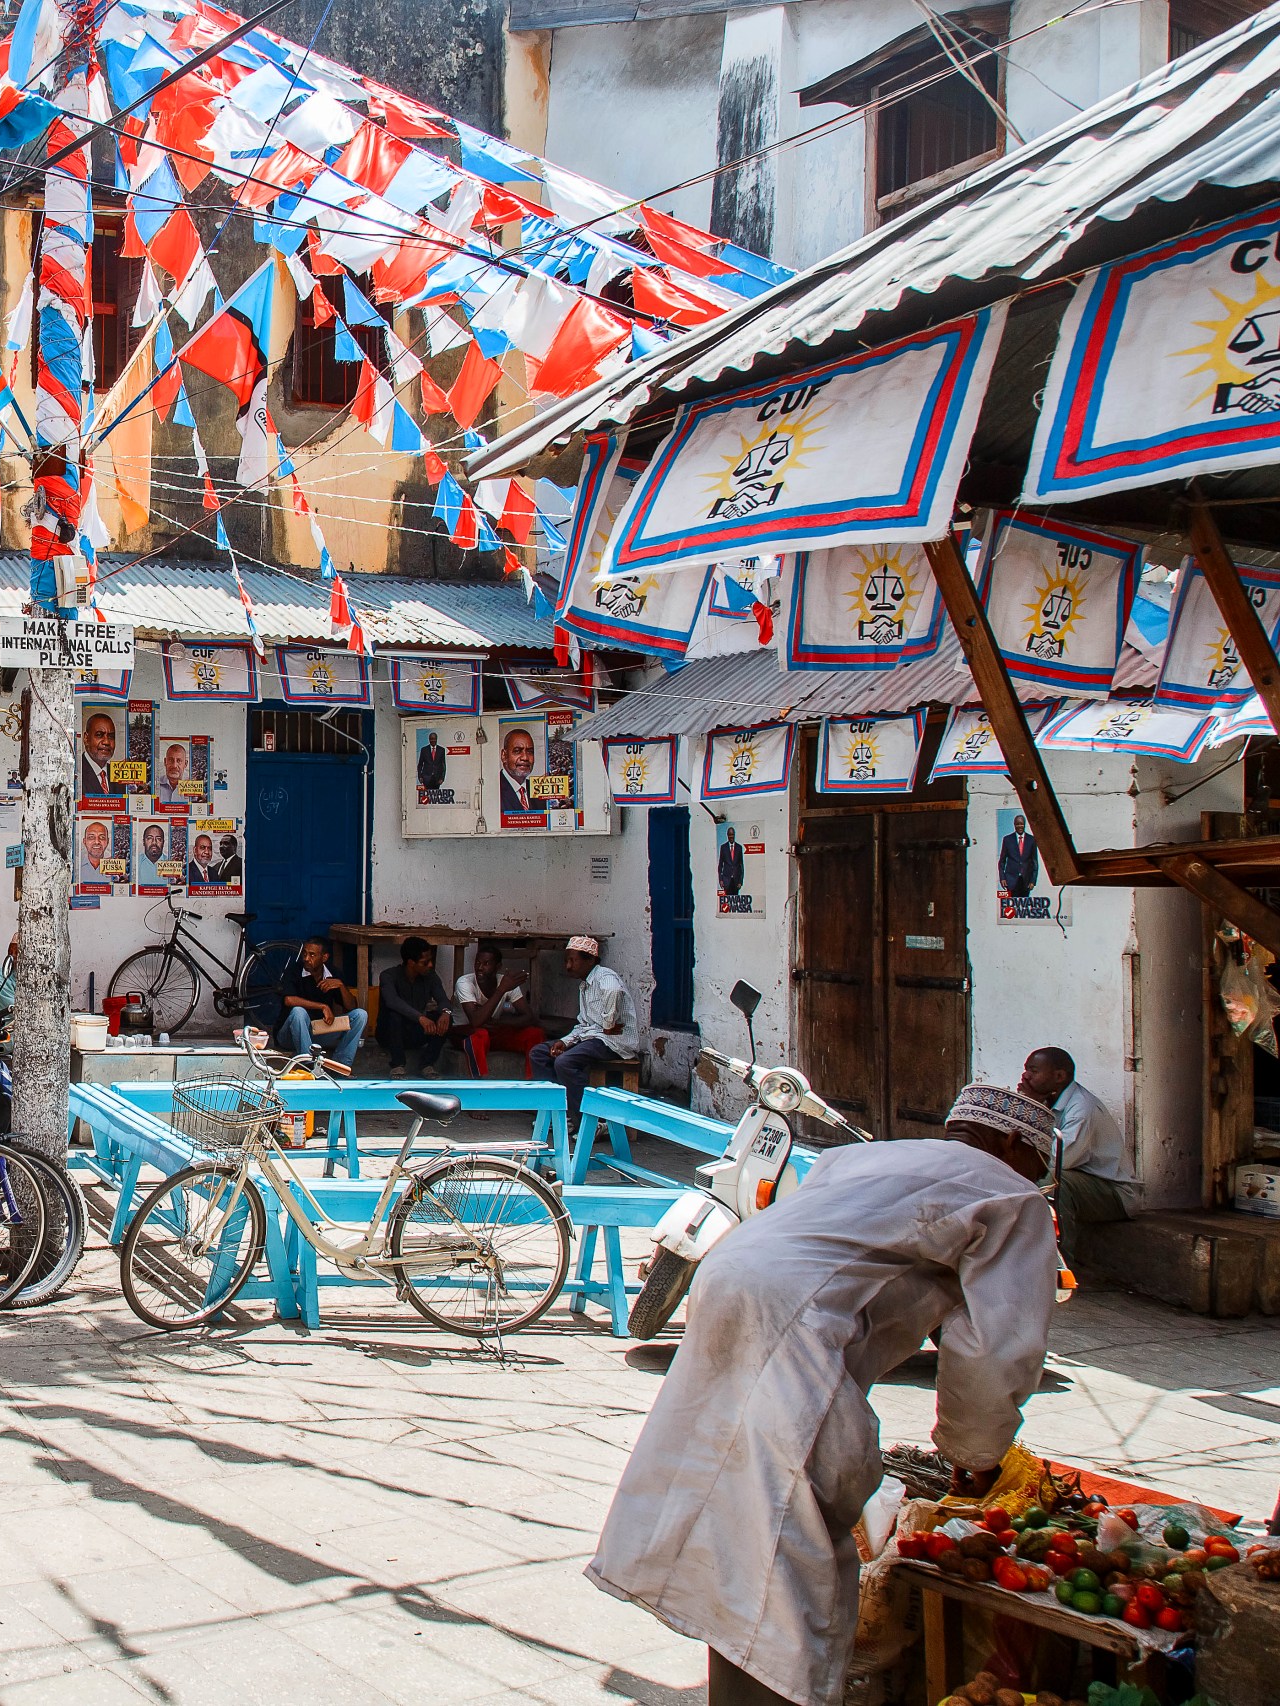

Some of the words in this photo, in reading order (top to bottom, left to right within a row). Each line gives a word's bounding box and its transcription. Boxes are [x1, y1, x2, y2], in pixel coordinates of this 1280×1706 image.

[757, 377, 834, 421] CUF
[75, 623, 116, 639] FREE
[95, 641, 131, 654] CALLS
[40, 652, 92, 667] PLEASE
[192, 649, 215, 659] CUF
[307, 652, 328, 661] CUF
[849, 721, 874, 734] CUF
[734, 732, 755, 744] CUF
[625, 745, 644, 755] CUF
[114, 770, 143, 780] SEIF
[418, 789, 455, 798] EDWARD
[533, 785, 564, 795] SEIF
[720, 895, 752, 905] EDWARD
[1000, 897, 1051, 908] EDWARD
[758, 1142, 776, 1158] AM
